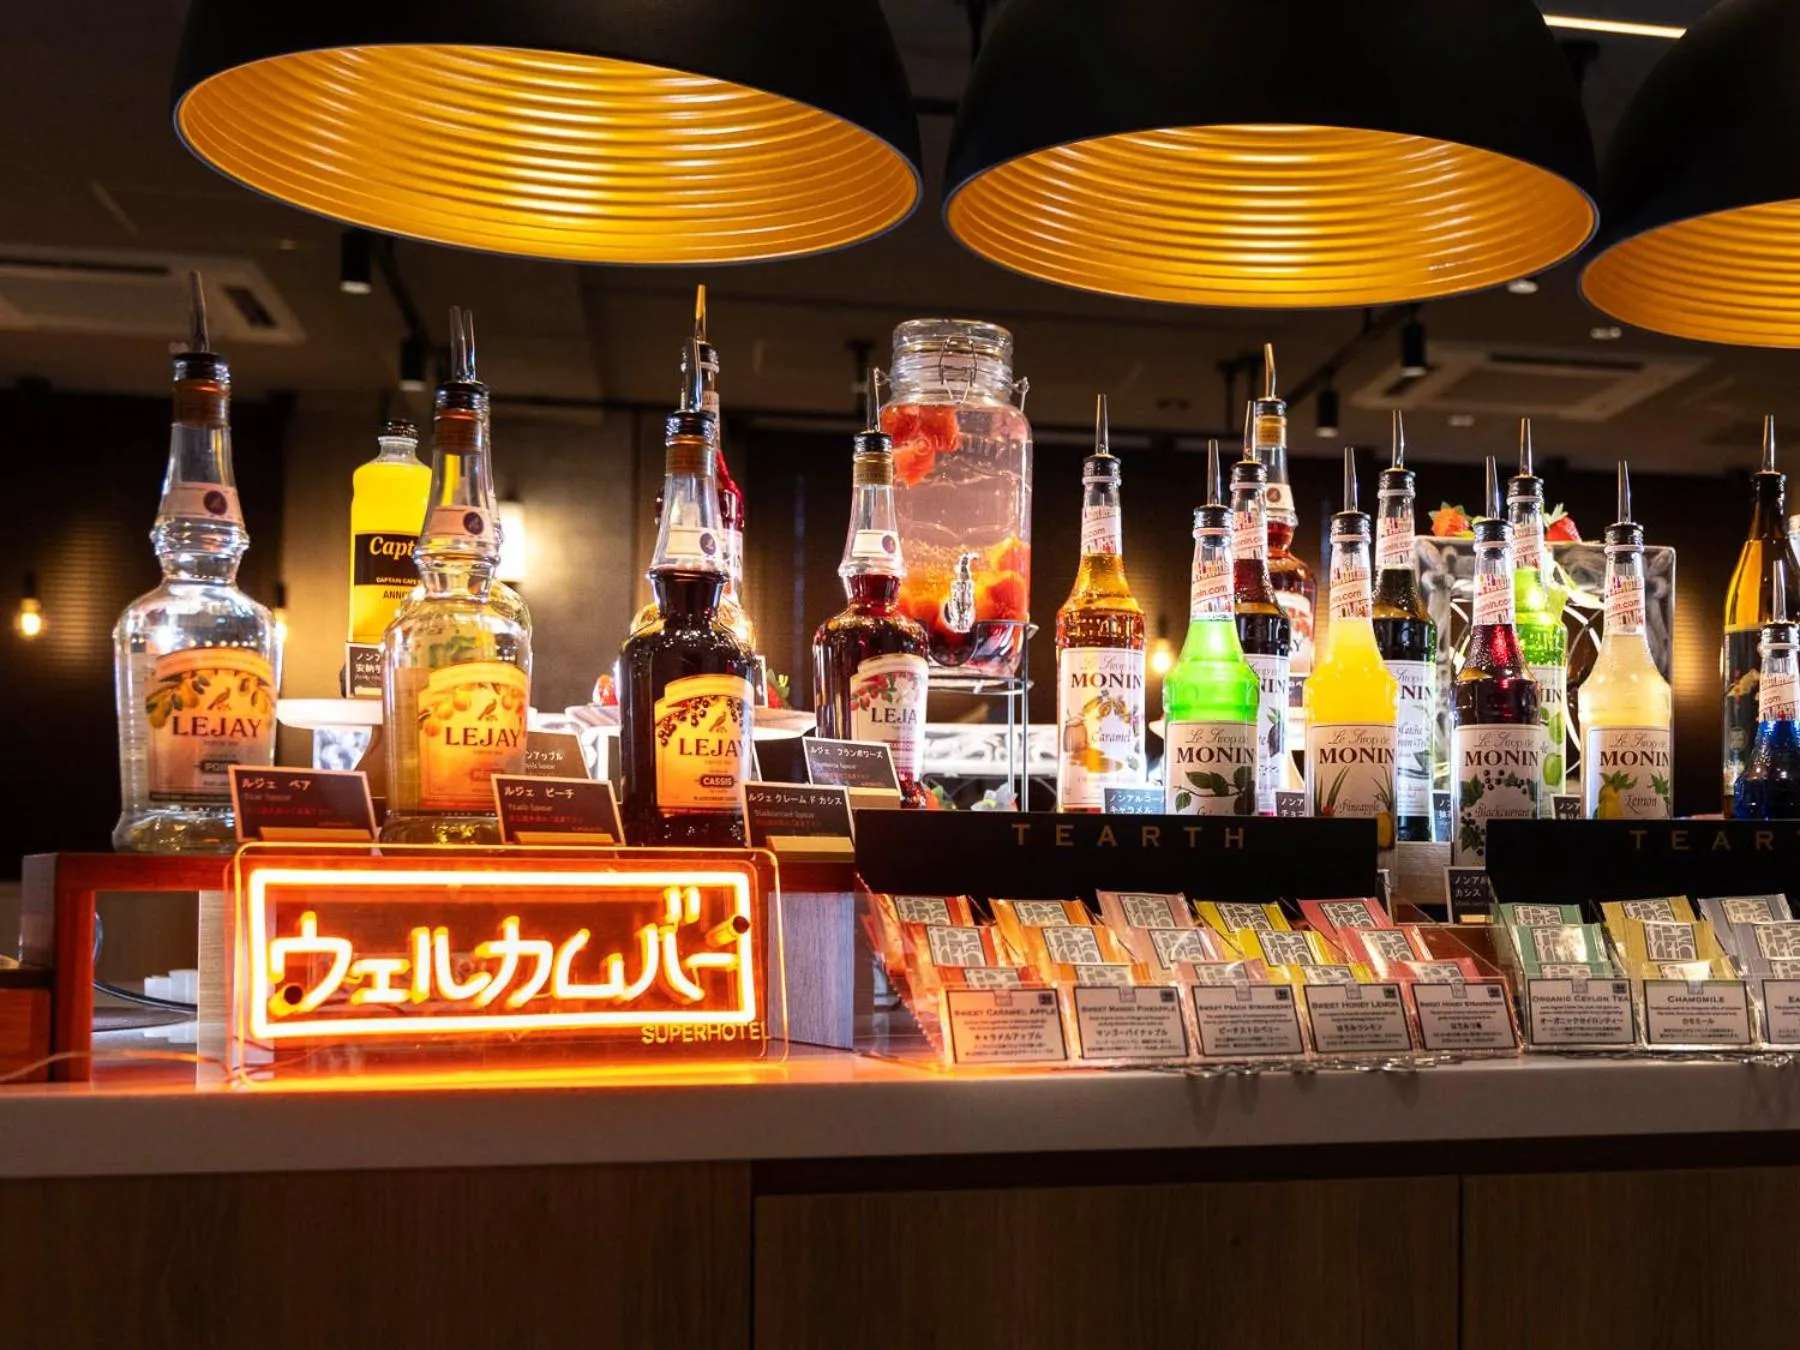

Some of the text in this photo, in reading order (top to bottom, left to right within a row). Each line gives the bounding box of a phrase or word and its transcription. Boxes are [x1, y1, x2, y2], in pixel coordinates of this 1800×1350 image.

[369, 536, 416, 560] Capt
[1071, 672, 1142, 689] MONIN
[871, 707, 918, 725] LEJA
[172, 715, 262, 738] LEJAY
[445, 727, 521, 747] LEJAY
[1177, 746, 1255, 764] MONIN
[1319, 747, 1394, 765] MONIN
[1465, 750, 1539, 767] MONIN
[1600, 750, 1669, 767] MONIN
[703, 776, 732, 786] CASSIS
[1011, 823, 1245, 849] TEARTH
[1629, 829, 1800, 851] TEAR
[269, 886, 740, 1009] ウェルカムバー
[1667, 995, 1725, 1003] CHAMOMILE
[641, 1021, 771, 1044] SUPERHOTEL
